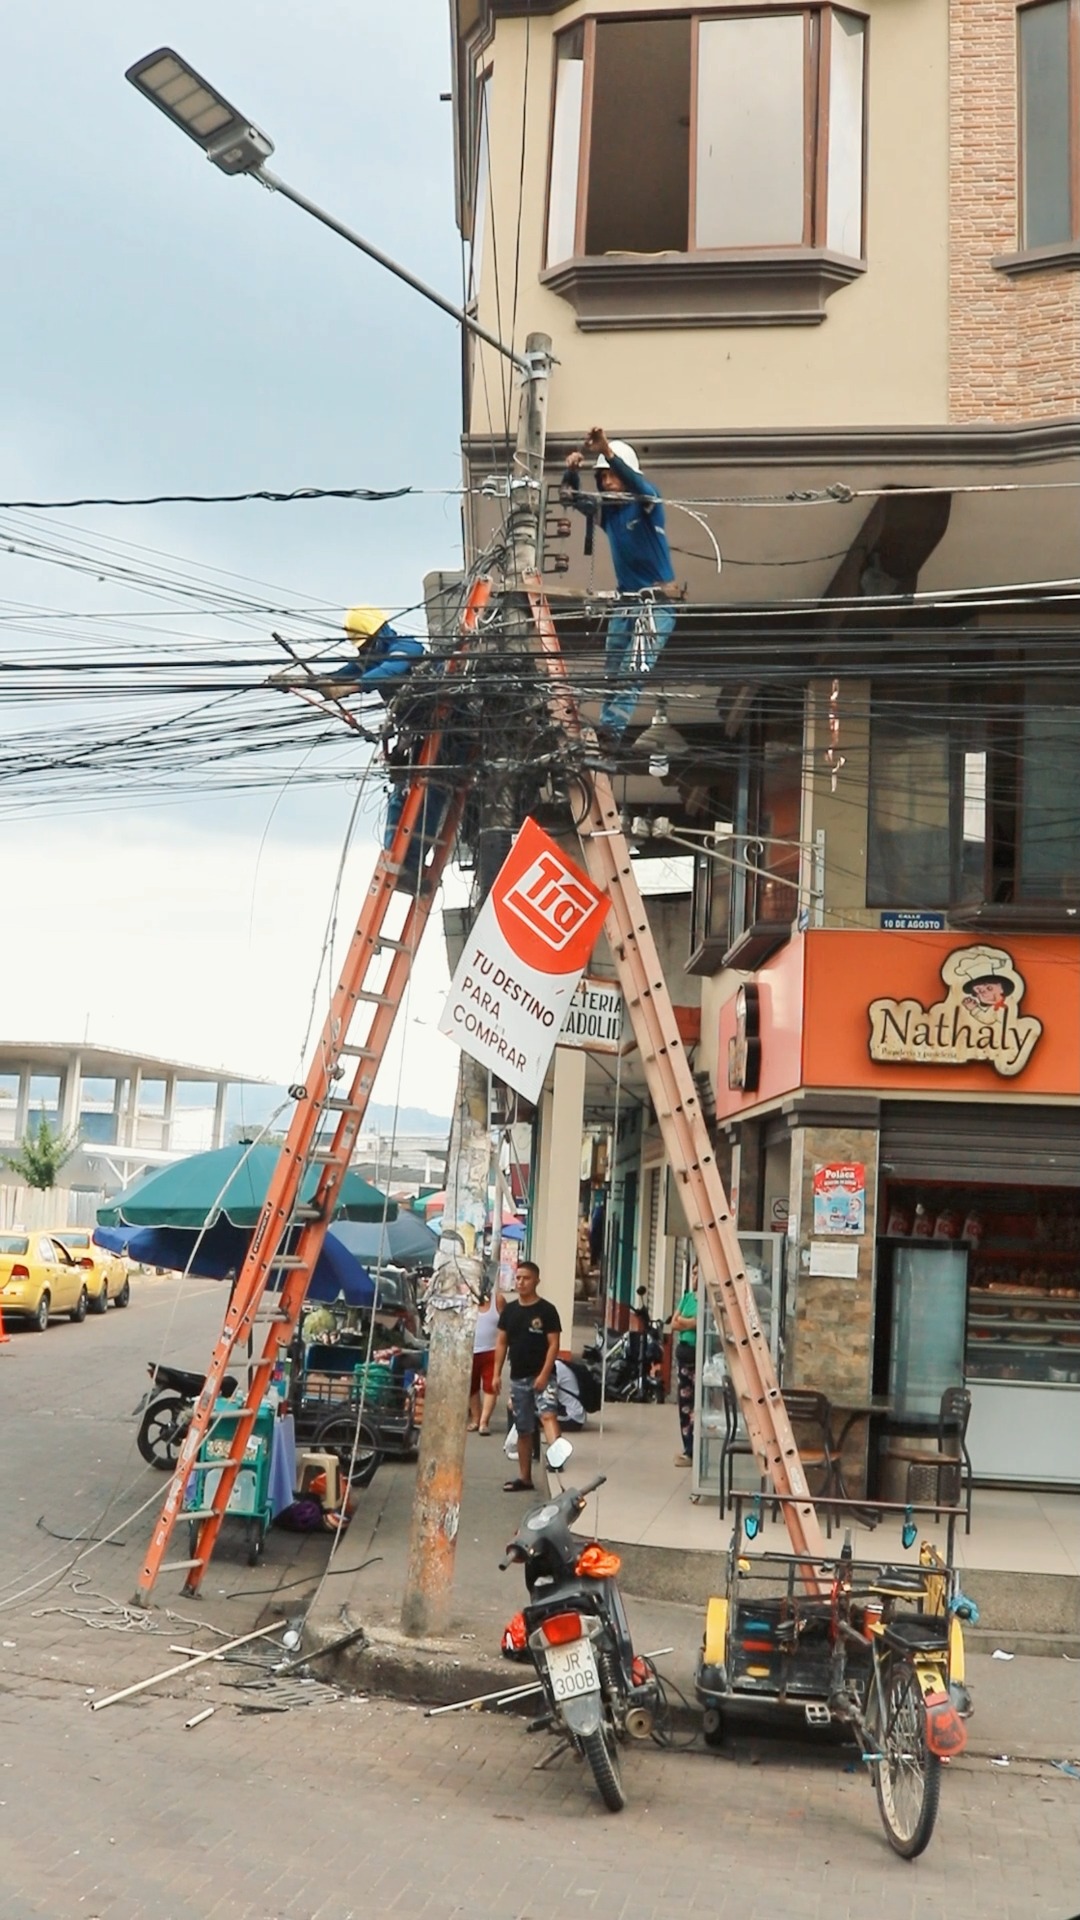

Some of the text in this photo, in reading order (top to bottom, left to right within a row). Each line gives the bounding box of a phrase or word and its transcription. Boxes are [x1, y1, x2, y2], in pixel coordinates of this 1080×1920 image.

[884, 920, 940, 929] 10 DE AGOSTO
[461, 976, 500, 1020] PARA
[472, 949, 555, 1027] TU DESTINO
[453, 1004, 527, 1073] COMPRAR
[560, 1011, 623, 1040] ADOLID
[880, 1005, 1033, 1065] Nathaly
[563, 1652, 581, 1673] JR
